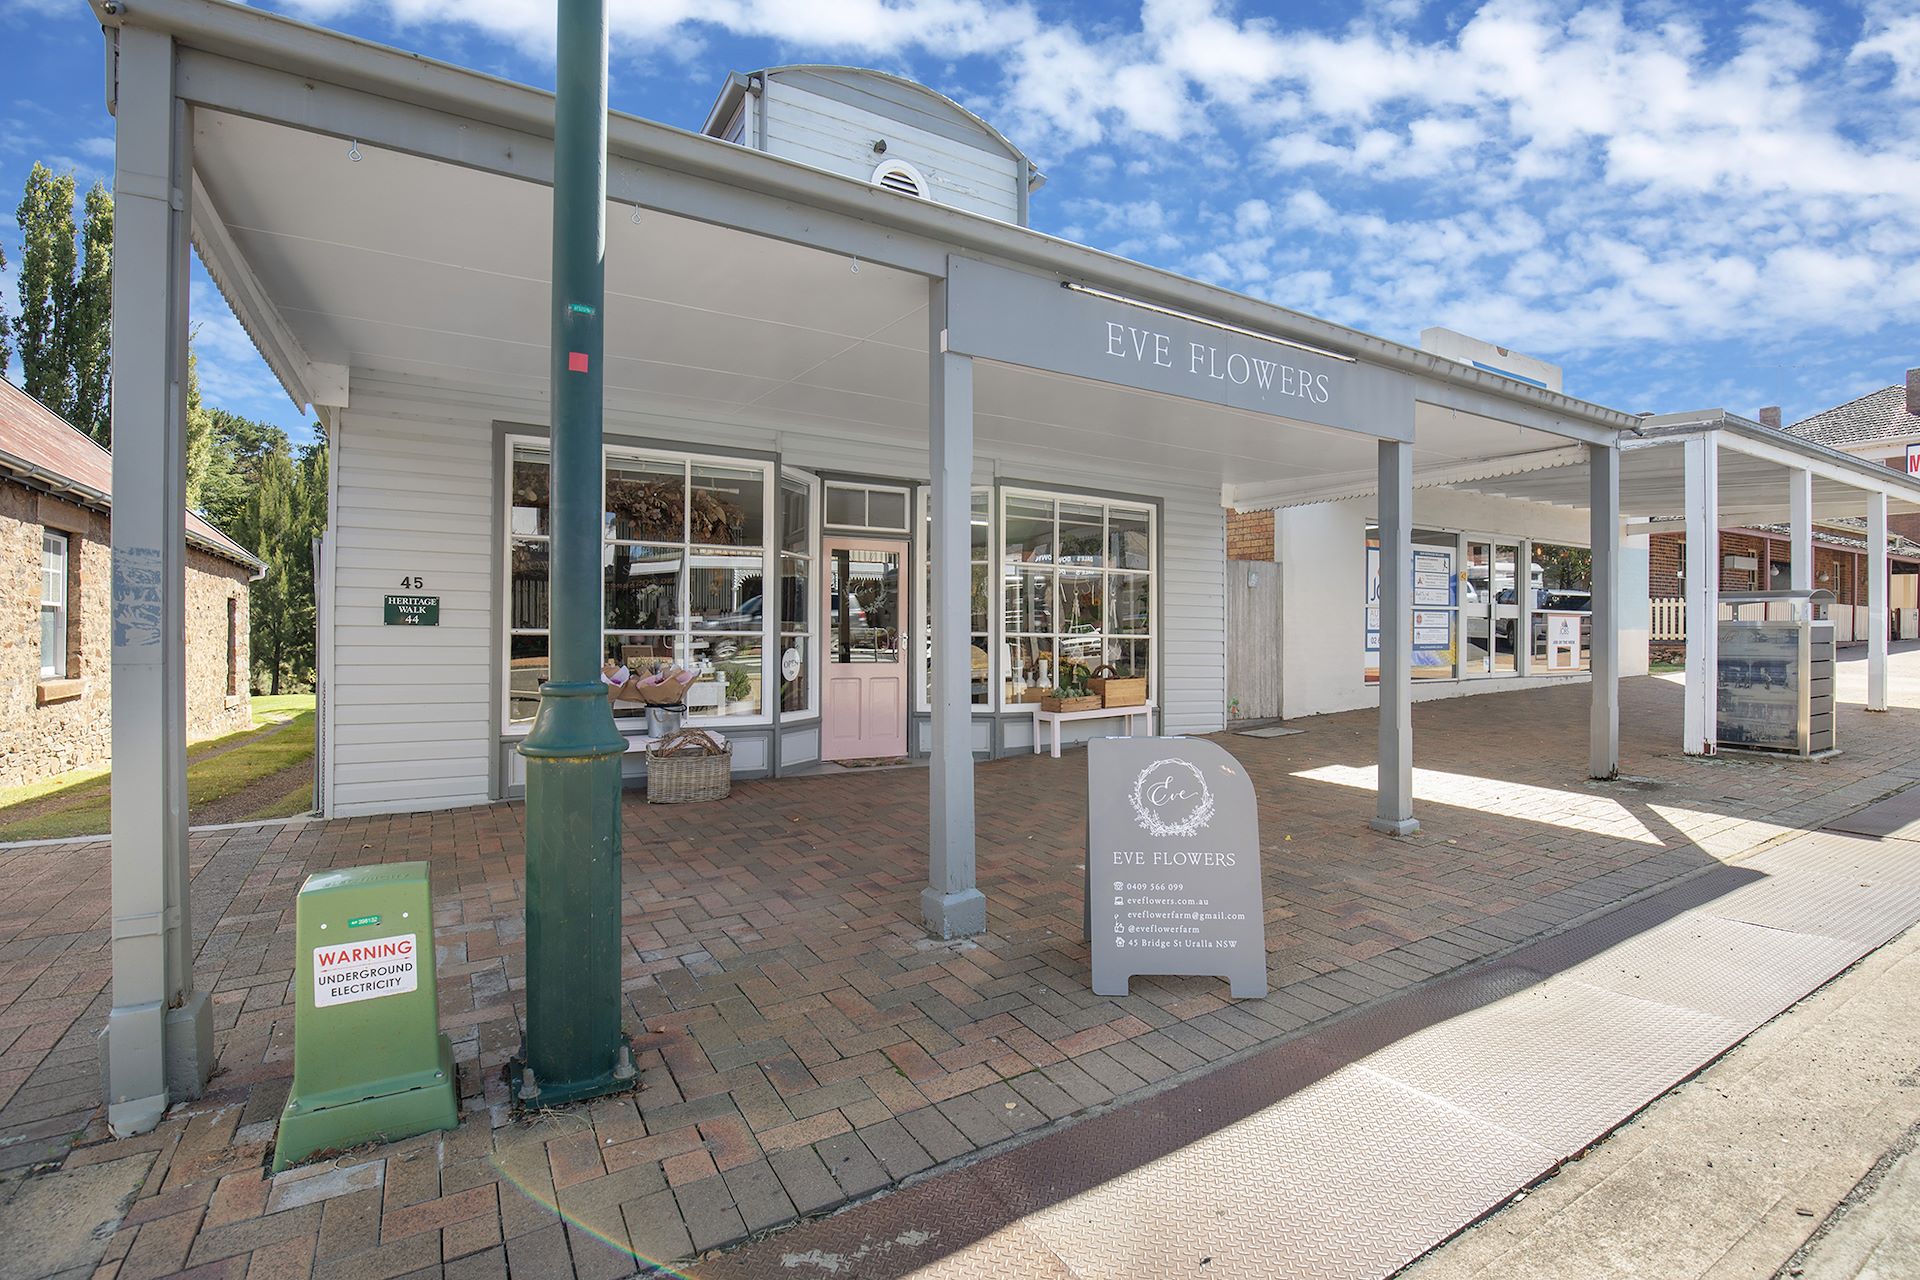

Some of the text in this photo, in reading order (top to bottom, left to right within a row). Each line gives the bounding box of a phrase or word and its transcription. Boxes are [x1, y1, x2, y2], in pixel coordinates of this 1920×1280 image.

[1105, 321, 1330, 404] EVE FLOWERS
[400, 576, 424, 589] 45
[388, 597, 437, 606] HERITAGE
[398, 605, 427, 614] WALK
[405, 615, 420, 624] 44
[1146, 775, 1199, 806] Eve
[1113, 852, 1236, 867] EVE FLOWERS
[1126, 882, 1184, 891] 0409 566 099
[1127, 896, 1209, 906] eveflowers.com.au
[1127, 910, 1245, 921] eveflowerfarm@gmail.com
[1127, 924, 1200, 933] @eveflowerfarm
[1128, 938, 1237, 949] 45 Bridge St Uralla NSW
[319, 940, 412, 967] WARNING
[318, 962, 413, 986] UNDERGROUND
[331, 977, 401, 997] ELECTRICITY
